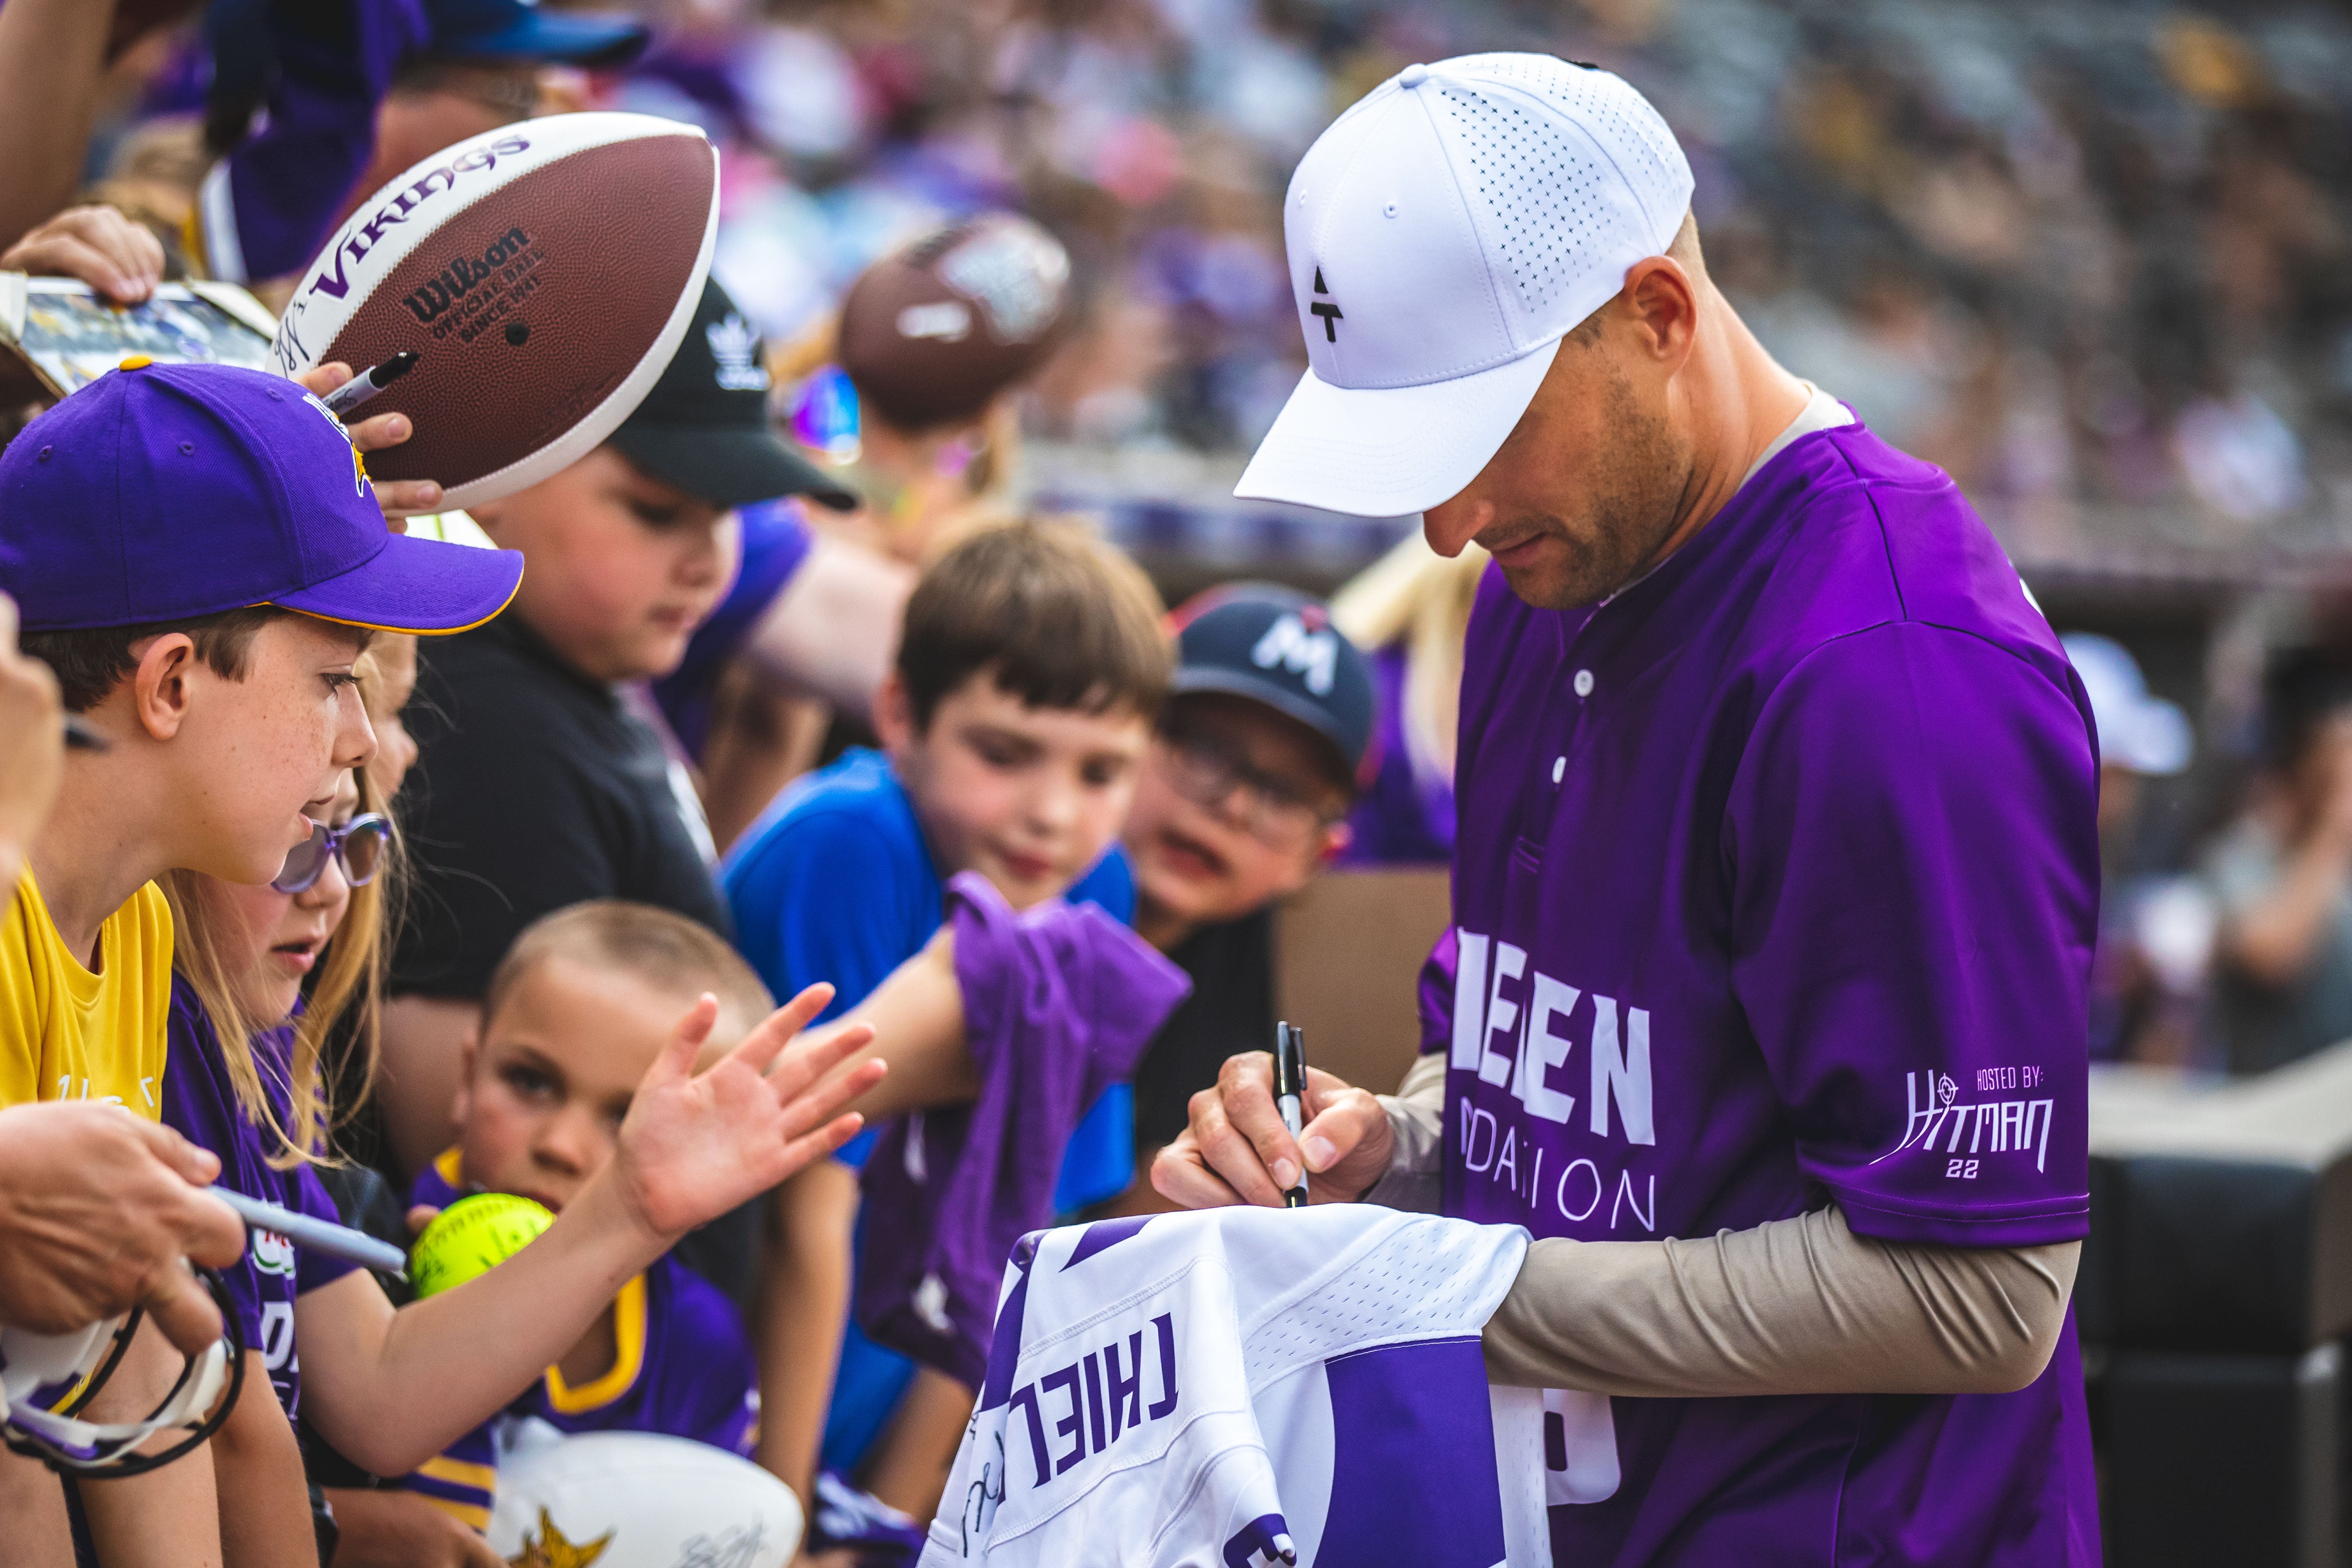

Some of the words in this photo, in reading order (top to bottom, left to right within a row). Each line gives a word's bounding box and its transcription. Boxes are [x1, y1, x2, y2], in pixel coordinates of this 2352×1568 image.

[405, 228, 531, 323] Wilson
[461, 301, 510, 342] SINCE
[1251, 612, 1339, 698] M
[1451, 926, 1656, 1146] IEEN
[1977, 1066, 2016, 1091] HOSTED
[2023, 1065, 2044, 1088] BY:
[1460, 1096, 1655, 1232] DAION
[1945, 1159, 1980, 1180] 22
[997, 1311, 1179, 1507] THIEL
